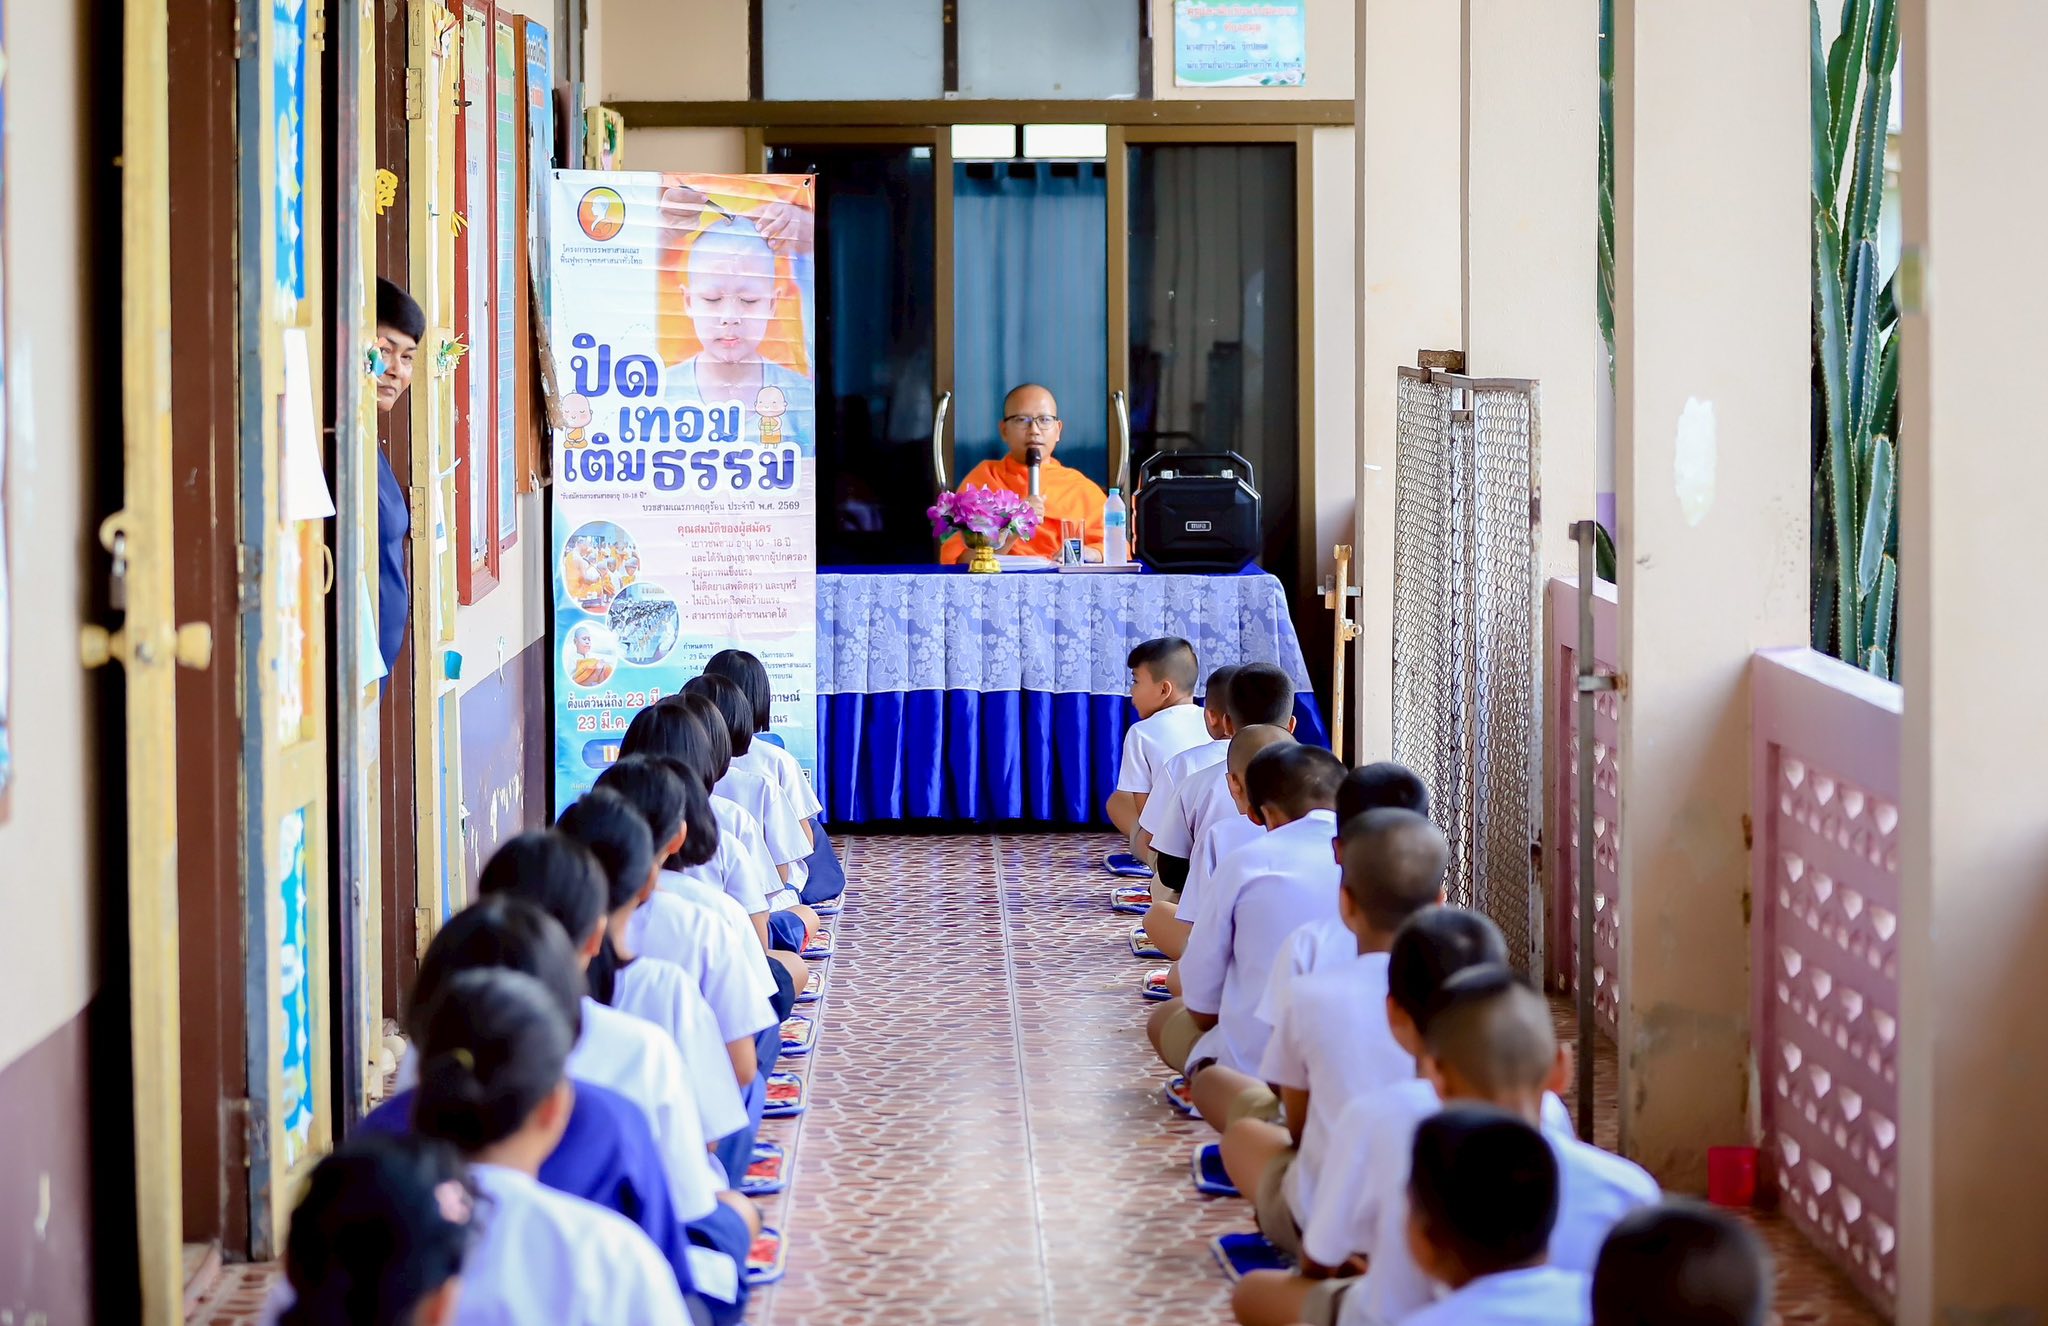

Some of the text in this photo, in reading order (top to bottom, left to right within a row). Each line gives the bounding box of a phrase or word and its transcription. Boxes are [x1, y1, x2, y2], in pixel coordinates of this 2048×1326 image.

[571, 333, 659, 398] ปิด
[619, 406, 740, 443] เทอม
[642, 501, 725, 514] บวชสามเณรภาคฤดูร้อน
[728, 501, 755, 511] ประจำปี
[778, 501, 800, 510] 2569
[677, 521, 772, 536] คุณสมบัติของผู้สมัคร
[737, 540, 752, 550] อายุ
[755, 539, 764, 547] 10
[774, 539, 783, 547] 18
[785, 537, 792, 547] ปี
[691, 552, 807, 565] และได้รับอนุญาตจากผู้ปกครอง
[691, 566, 752, 579] มีสุขภาพแข็งแรง
[692, 577, 797, 593] ไม่ติดยาเสพติดสุรา และบุหรี่
[692, 594, 780, 606] ไม่เป็นโรคติดต่อร้ายแรง
[691, 607, 788, 620] สามารถท่องคำขานนาคได้
[683, 642, 713, 650] กำหนดการ
[567, 691, 623, 709] ตั้งแต่วันนี้ถึง
[626, 693, 645, 707] 23
[770, 689, 801, 702] ภาษณ์
[578, 711, 629, 730] 23 มี.ค.
